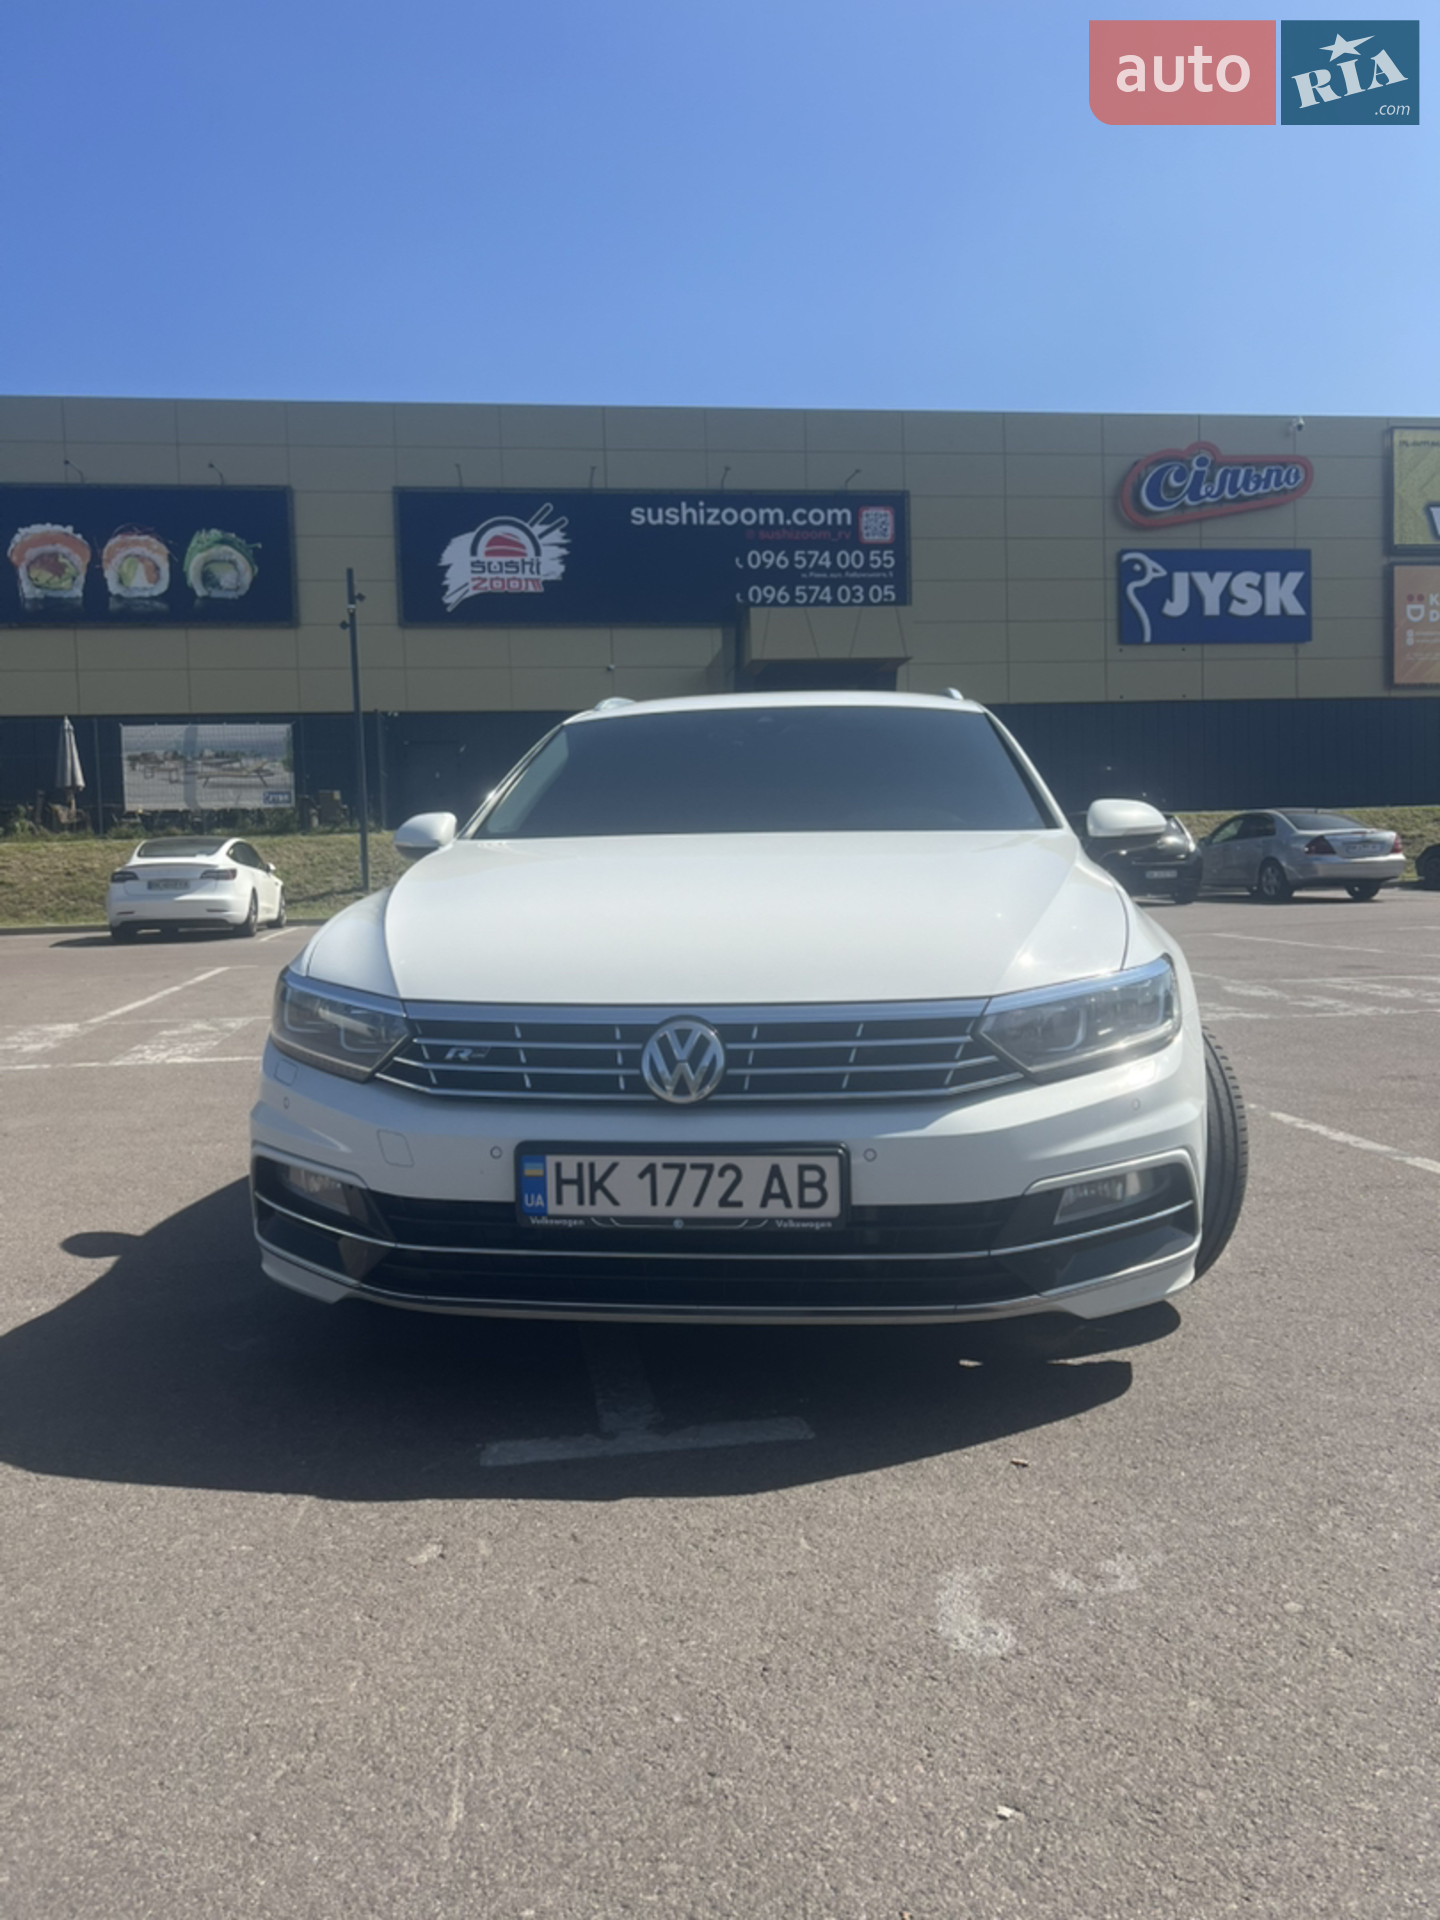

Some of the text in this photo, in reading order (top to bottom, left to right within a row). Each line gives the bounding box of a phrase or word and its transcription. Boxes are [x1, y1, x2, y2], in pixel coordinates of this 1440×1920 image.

[1141, 453, 1305, 512] Сільпо
[630, 501, 852, 526] sushizoom.com
[758, 527, 851, 542] sushizoom_rv
[747, 550, 895, 569] 096 574 00 55
[748, 585, 896, 604] 096 574 03 05
[1161, 571, 1306, 618] JYSK
[555, 1161, 829, 1209] HK 1772 AB
[524, 1193, 545, 1208] UA
